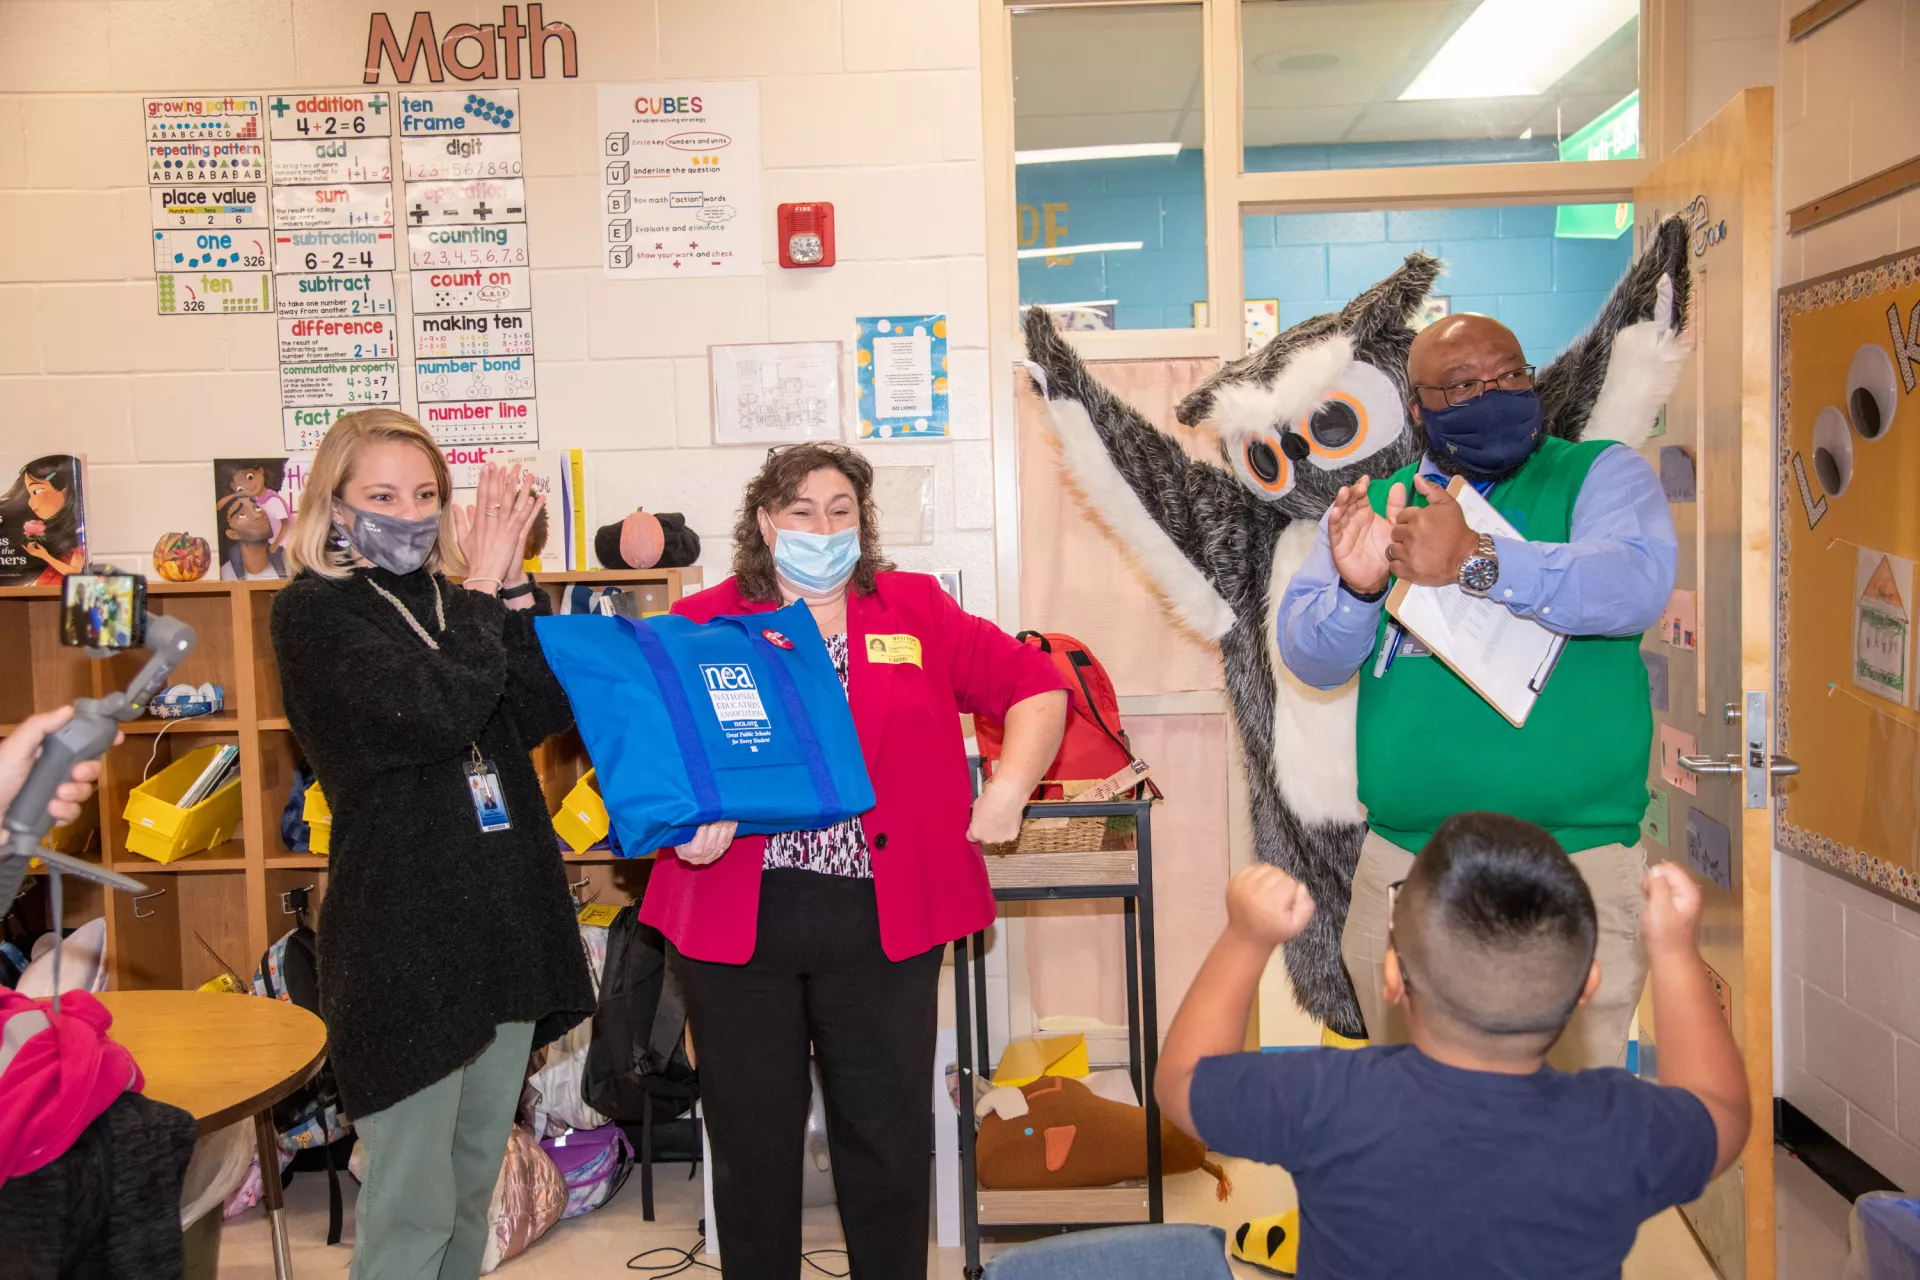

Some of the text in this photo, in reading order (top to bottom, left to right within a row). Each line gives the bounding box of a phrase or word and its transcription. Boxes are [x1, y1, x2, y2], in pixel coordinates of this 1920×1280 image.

[363, 3, 578, 84] Math
[148, 98, 257, 115] growing pattern
[295, 96, 363, 113] addition
[402, 96, 433, 112] ten
[635, 96, 703, 114] CUBES
[403, 115, 465, 131] frame
[150, 143, 260, 158] repeating pattern
[316, 141, 347, 158] add
[446, 138, 482, 158] digit
[611, 142, 619, 152] C
[612, 171, 619, 181] U
[688, 166, 721, 175] question
[162, 188, 257, 208] place value
[315, 189, 349, 203] sum
[672, 196, 702, 204] "action"
[613, 200, 620, 209] B
[179, 215, 242, 225] 3 2 6
[613, 229, 621, 238] E
[688, 224, 725, 232] eliminate
[196, 235, 232, 250] one
[292, 230, 377, 246] subtraction
[429, 226, 508, 246] counting
[243, 256, 266, 267] 326
[614, 255, 621, 264] S
[712, 250, 733, 258] check
[201, 274, 233, 293] ten
[299, 274, 371, 293] subtract
[430, 270, 511, 287] count on
[183, 301, 205, 312] 326
[291, 320, 383, 337] difference
[423, 314, 523, 333] making ten
[283, 362, 395, 375] commutative property
[418, 357, 521, 374] number bond
[295, 409, 331, 426] fact
[428, 402, 528, 421] number line
[2, 547, 15, 555] the
[705, 667, 753, 689] nea
[713, 692, 757, 700] NATIONAL
[716, 701, 761, 710] EDUCATION
[720, 709, 764, 718] ASSOCIATION
